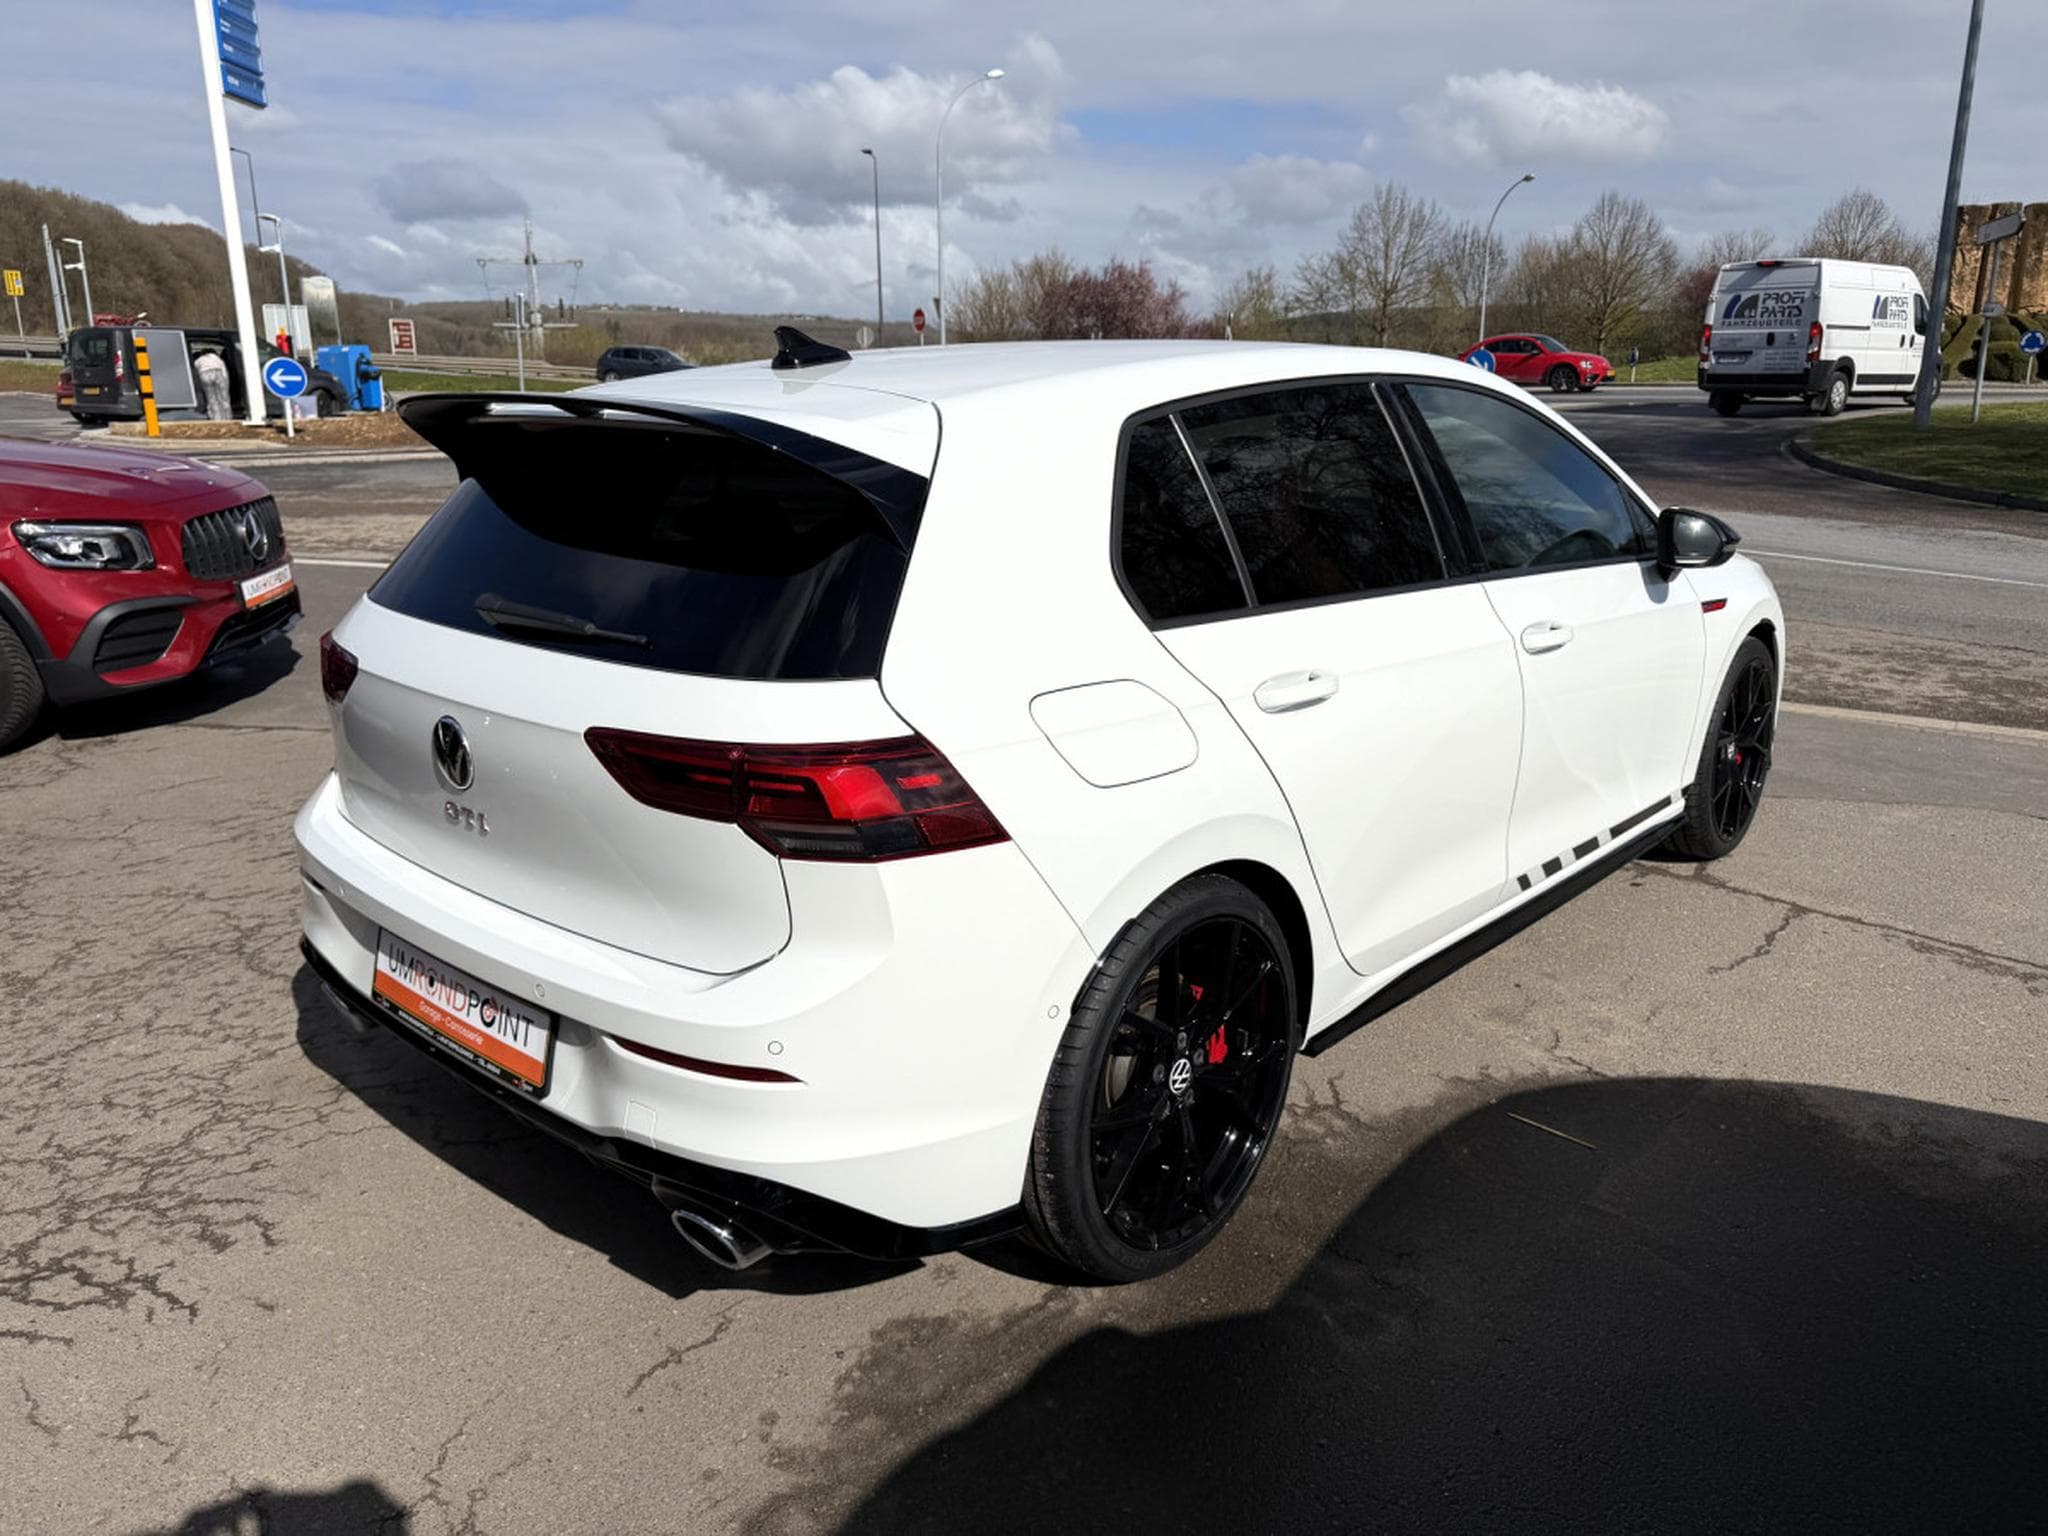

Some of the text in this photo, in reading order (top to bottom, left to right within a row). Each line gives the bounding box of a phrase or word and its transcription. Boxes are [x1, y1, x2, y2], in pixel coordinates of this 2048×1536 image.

[1762, 291, 1806, 304] PROFI
[1760, 306, 1802, 319] PARTS
[444, 800, 490, 834] GTI
[418, 1000, 443, 1023] Garage
